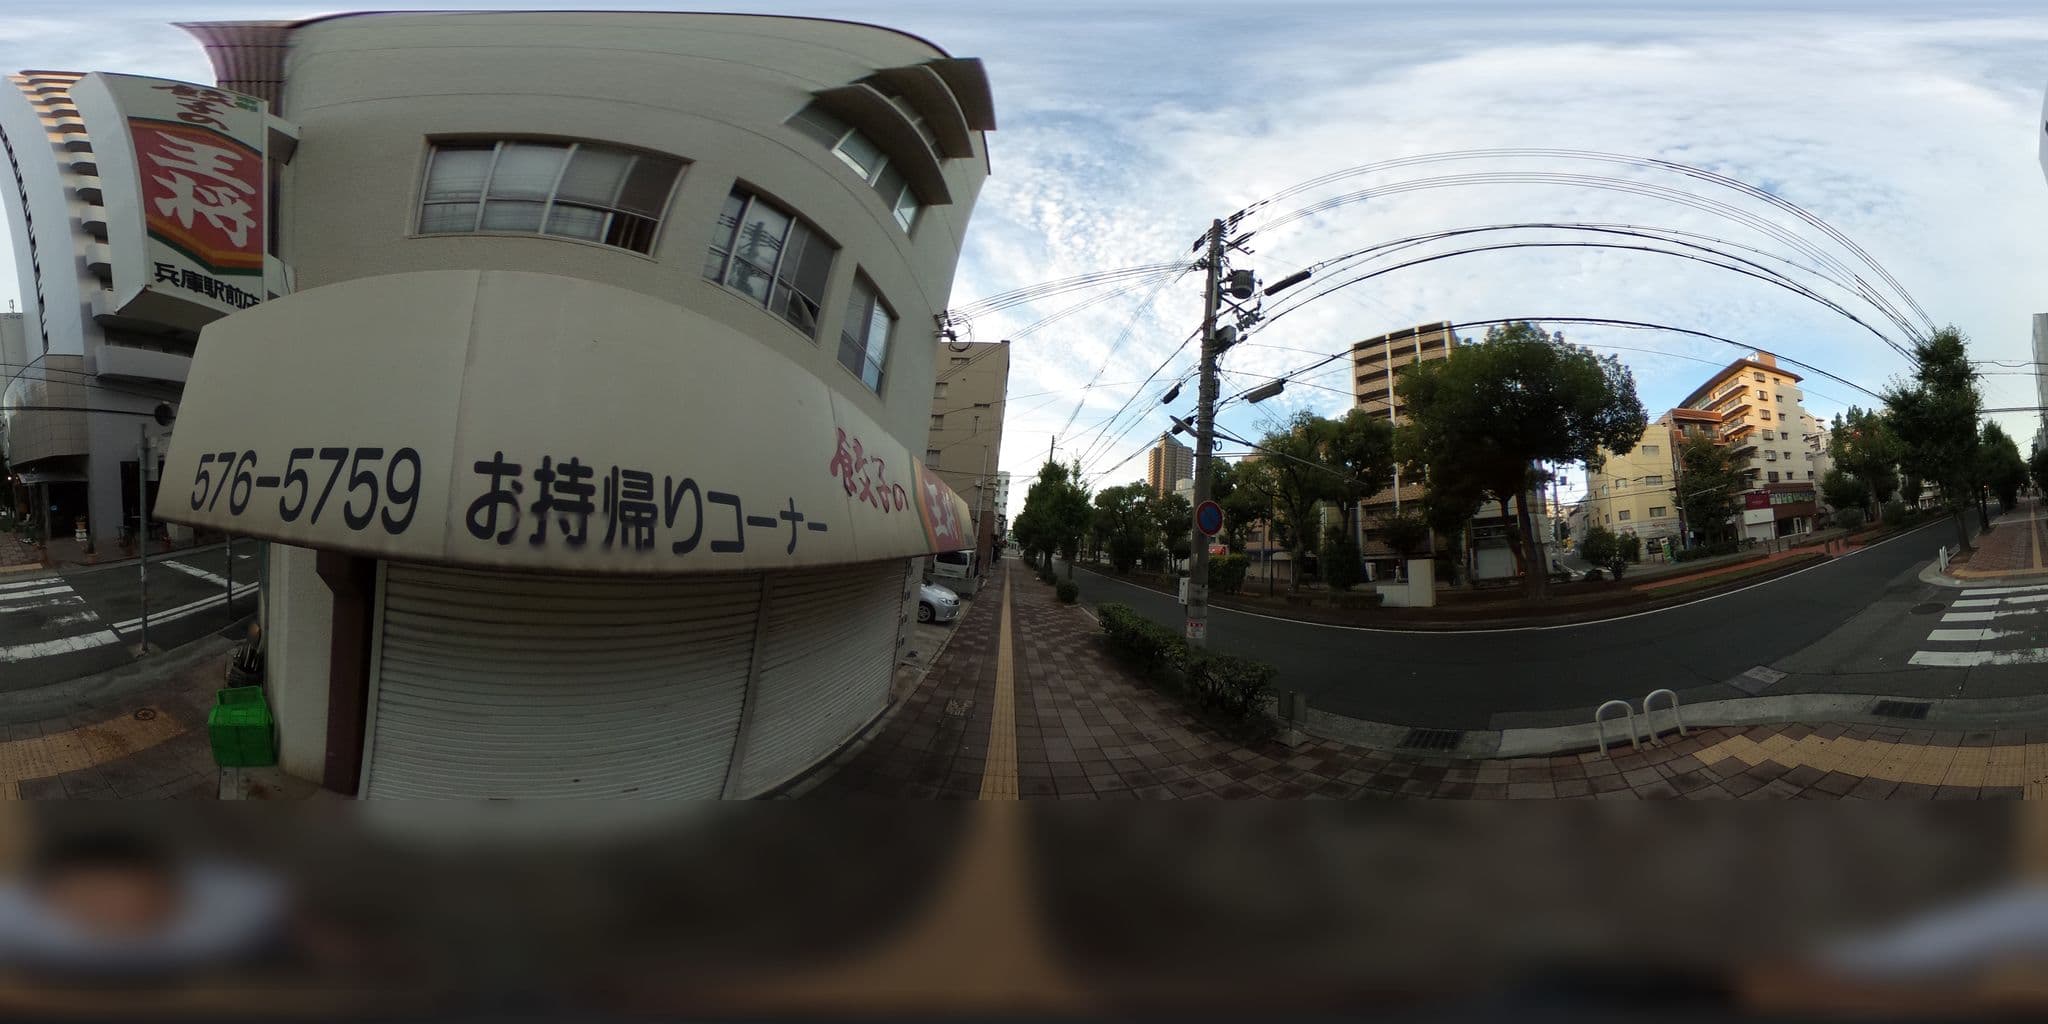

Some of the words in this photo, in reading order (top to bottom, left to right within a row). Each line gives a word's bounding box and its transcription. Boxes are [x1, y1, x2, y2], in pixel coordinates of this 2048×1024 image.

[147, 131, 257, 248] 王将
[154, 261, 260, 310] 兵庫駅前店
[190, 446, 423, 536] 576-5759
[465, 450, 829, 556] お持帰りコーナー
[830, 427, 909, 514] 餃子の
